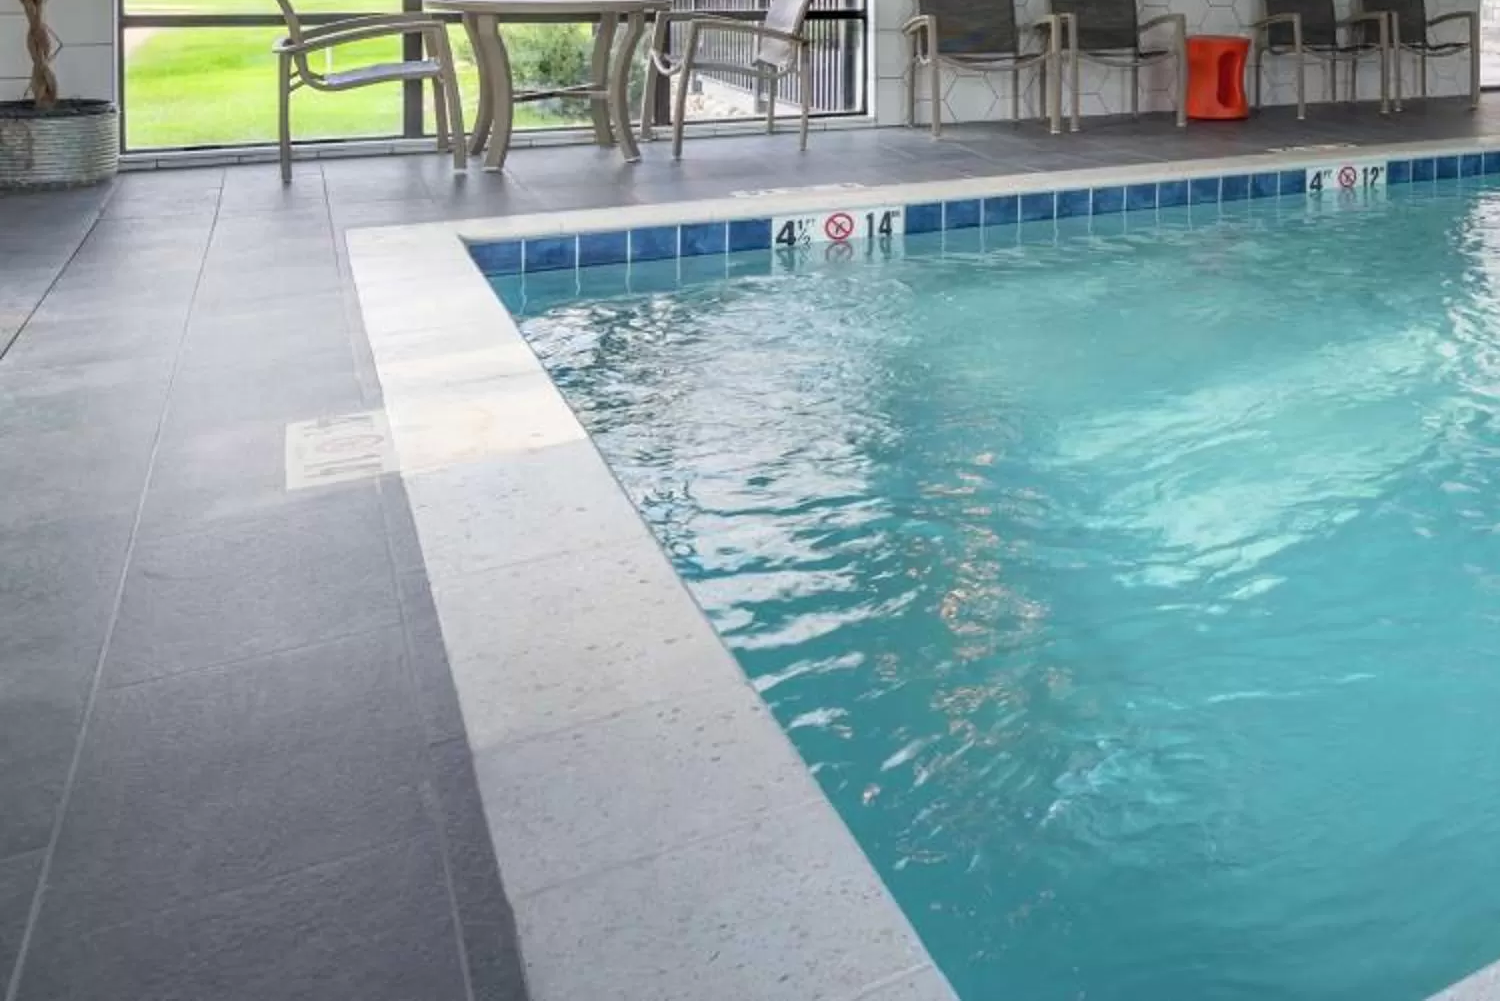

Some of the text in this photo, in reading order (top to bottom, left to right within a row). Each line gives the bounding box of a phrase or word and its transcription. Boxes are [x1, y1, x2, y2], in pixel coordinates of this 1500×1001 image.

[1310, 171, 1322, 191] 4
[776, 220, 796, 246] 4
[866, 211, 892, 237] 14
